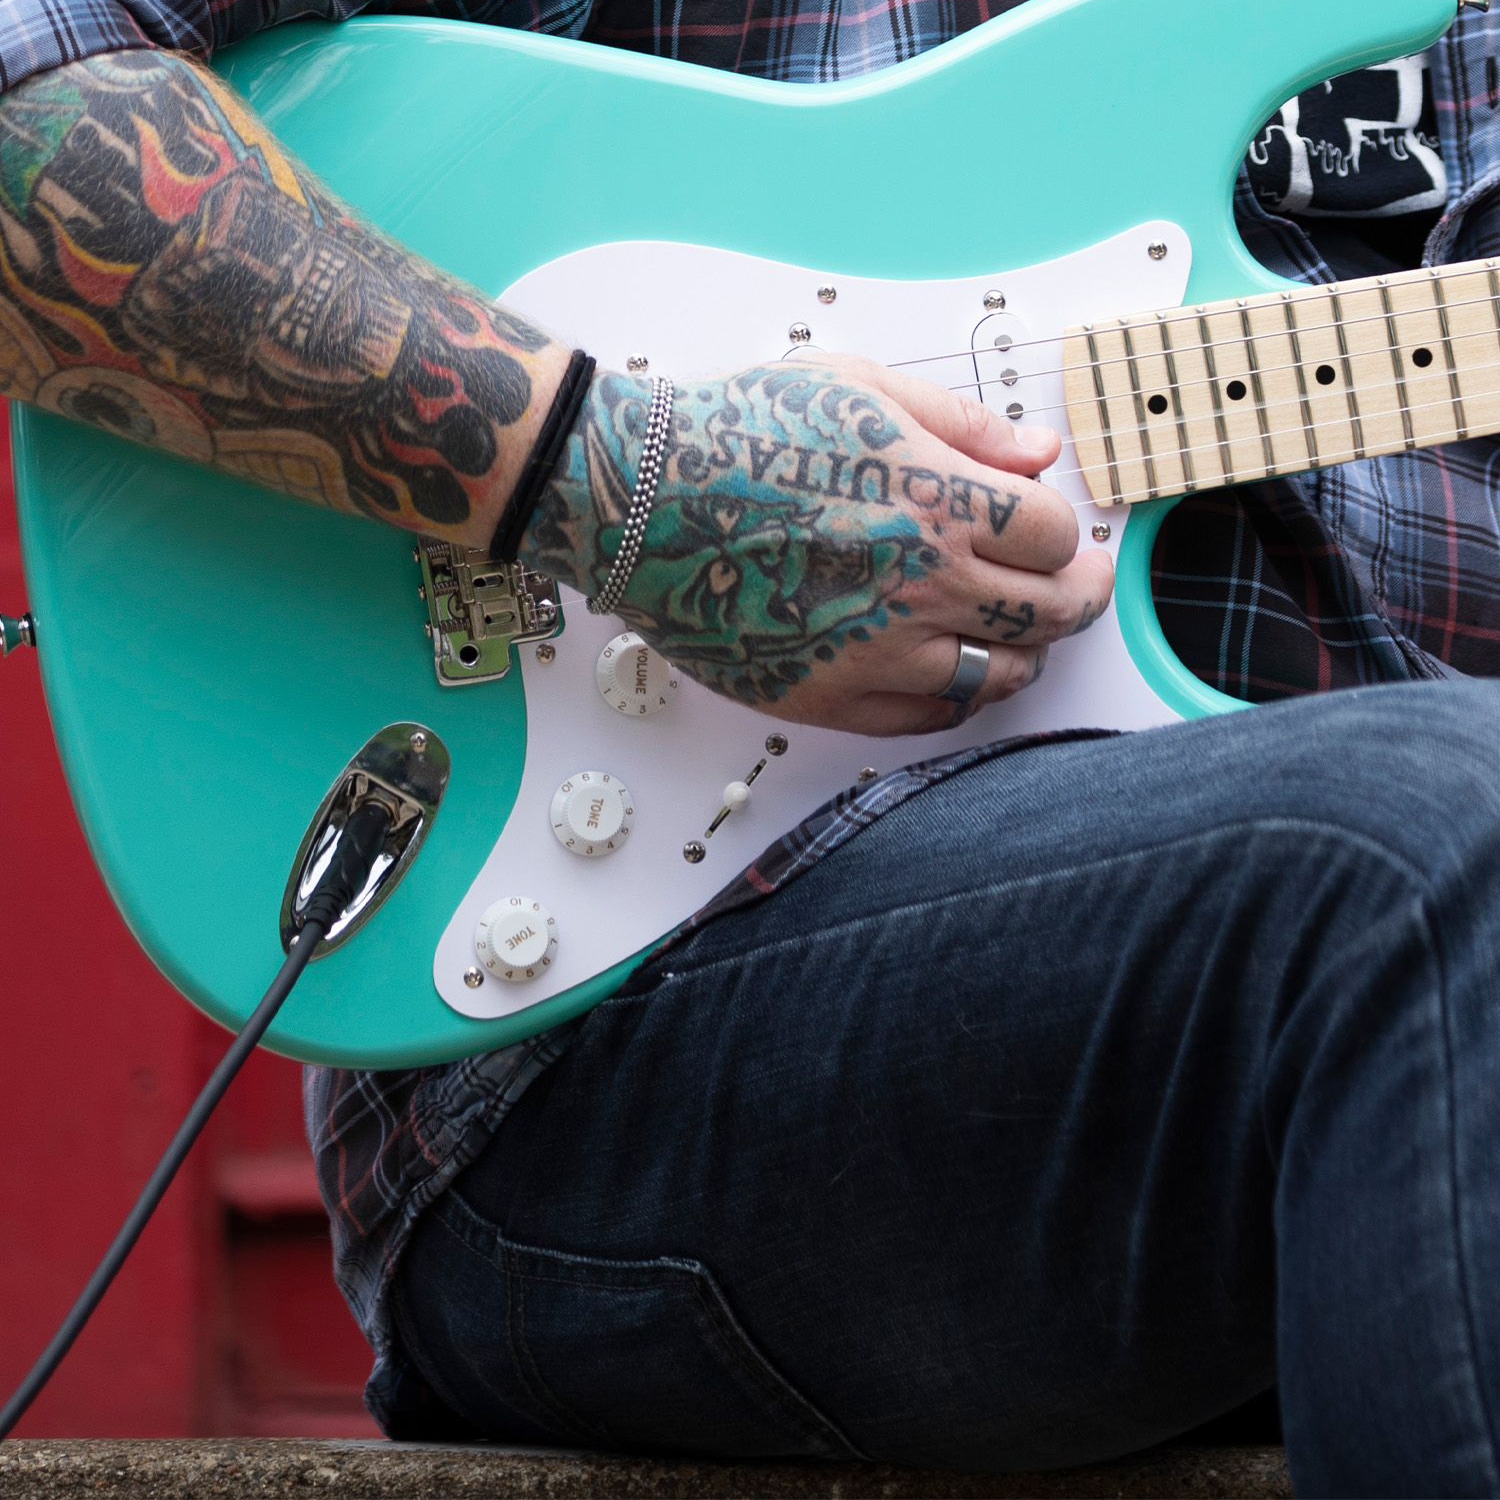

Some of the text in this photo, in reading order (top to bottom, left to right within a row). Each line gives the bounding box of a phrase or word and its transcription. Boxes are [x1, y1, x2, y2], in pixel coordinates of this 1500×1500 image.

[708, 429, 1022, 537] AEQUITAS
[635, 647, 648, 695] VOLUME
[561, 781, 574, 793] 10
[587, 798, 604, 829] TONE
[510, 897, 522, 906] 10
[505, 926, 536, 951] TONE
